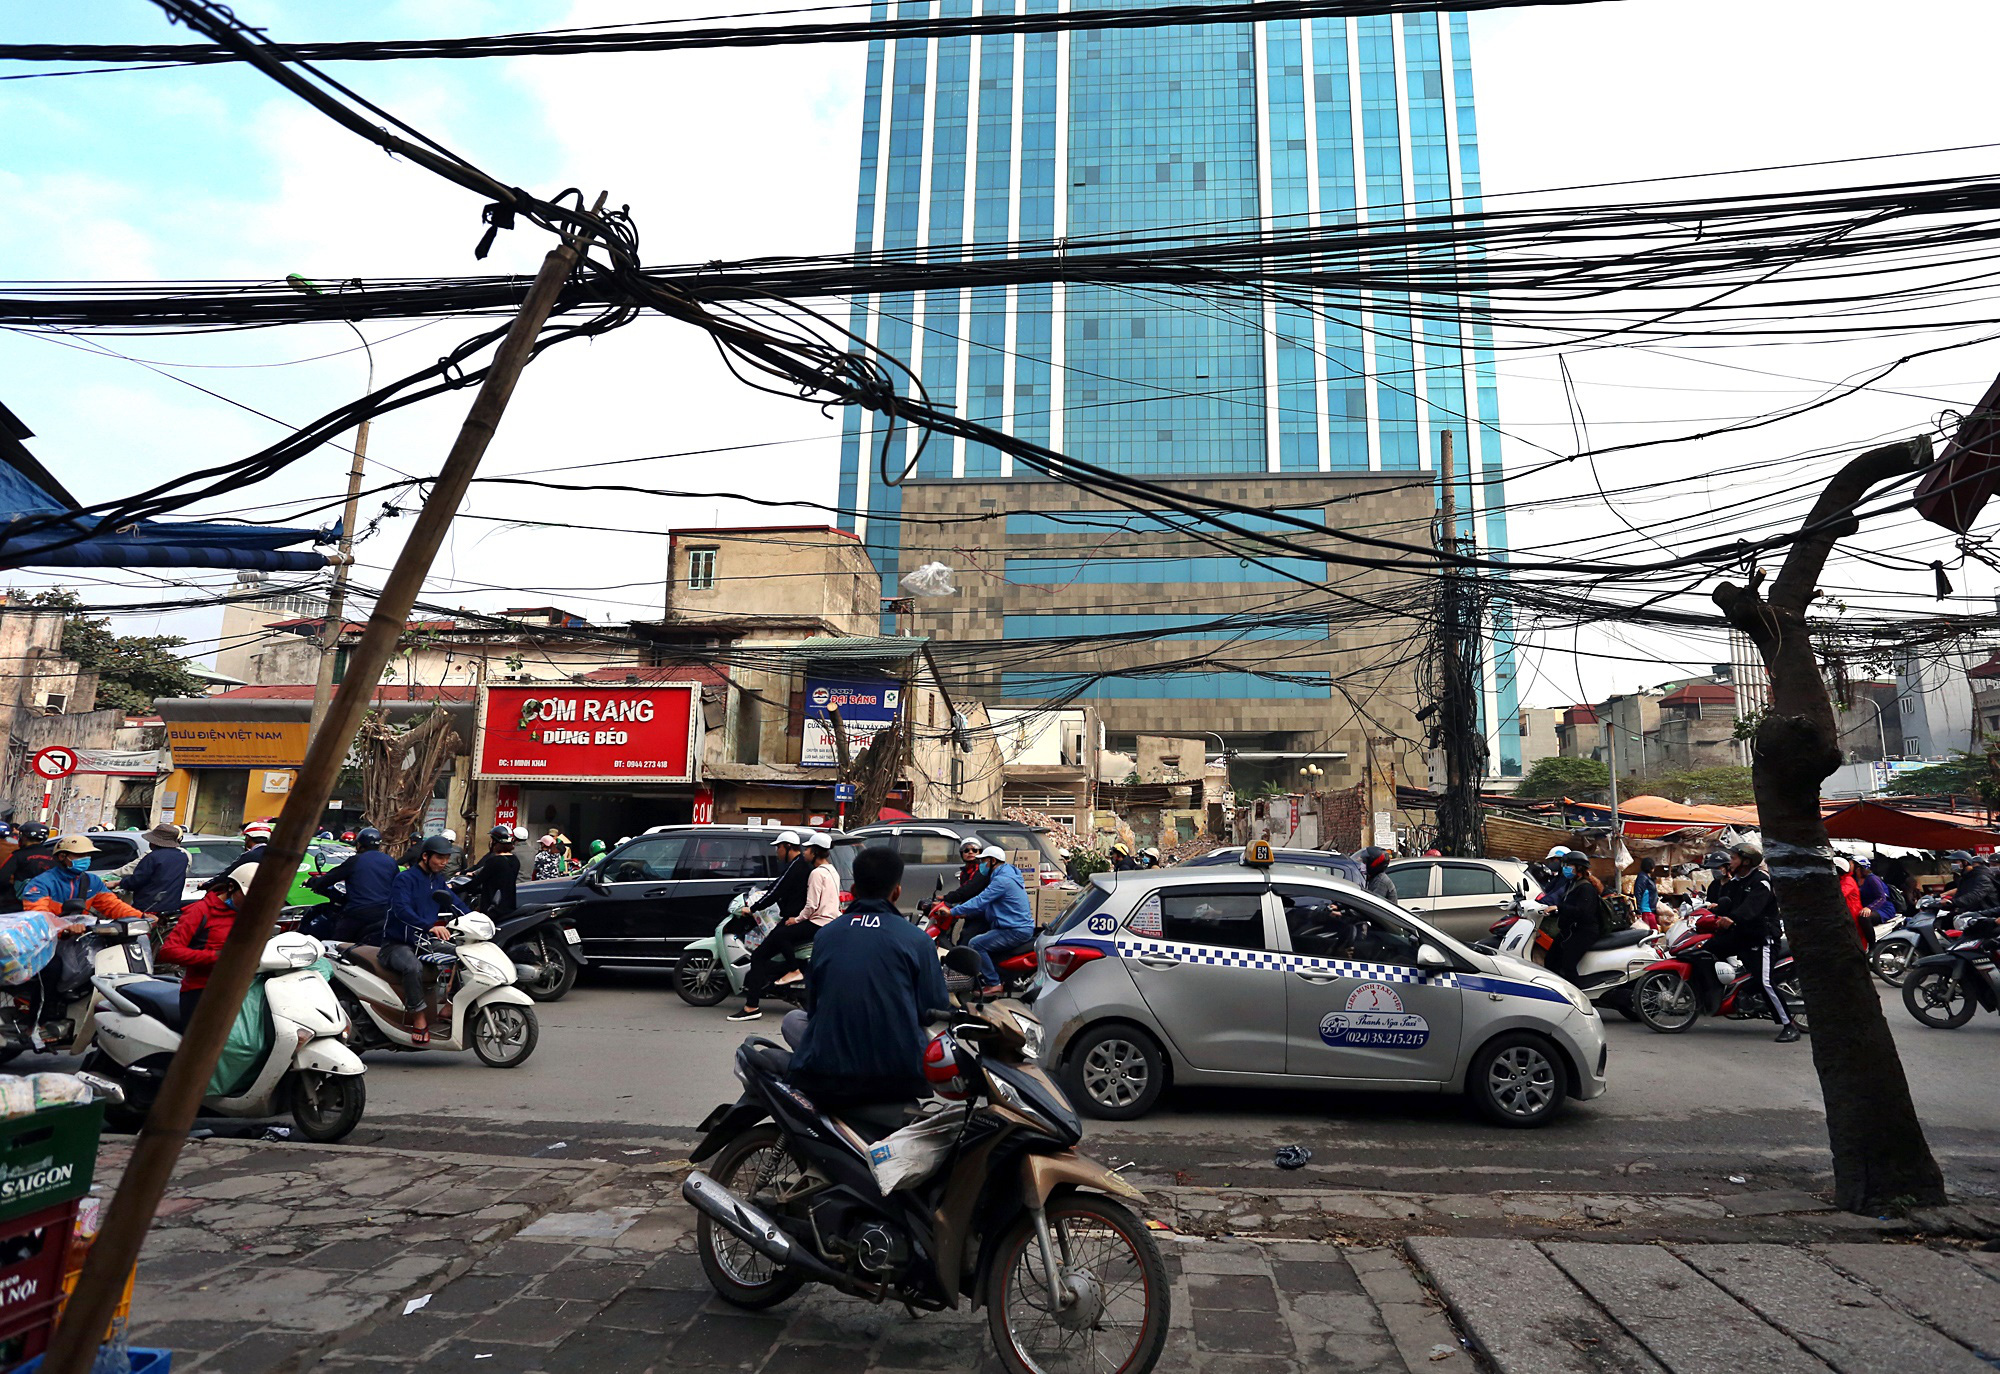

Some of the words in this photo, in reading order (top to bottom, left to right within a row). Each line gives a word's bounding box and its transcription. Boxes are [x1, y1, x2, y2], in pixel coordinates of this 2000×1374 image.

[583, 699, 654, 722] RANG
[198, 728, 226, 742] ĐIỆN
[228, 728, 252, 742] VIỆT
[256, 731, 283, 740] NAM
[543, 727, 590, 745] DŨNG
[595, 727, 628, 745] BÉO
[514, 759, 530, 767] MINH
[531, 759, 547, 767] KHAI
[626, 760, 643, 768] 0944
[498, 808, 515, 818] PHỞ
[693, 802, 713, 823] CƠM
[850, 914, 881, 928] FILA
[1090, 917, 1115, 931] 230
[1357, 983, 1375, 995] MINH
[1376, 983, 1393, 996] TAXI
[974, 1114, 999, 1128] HONDA
[0, 1163, 74, 1198] SAIGON
